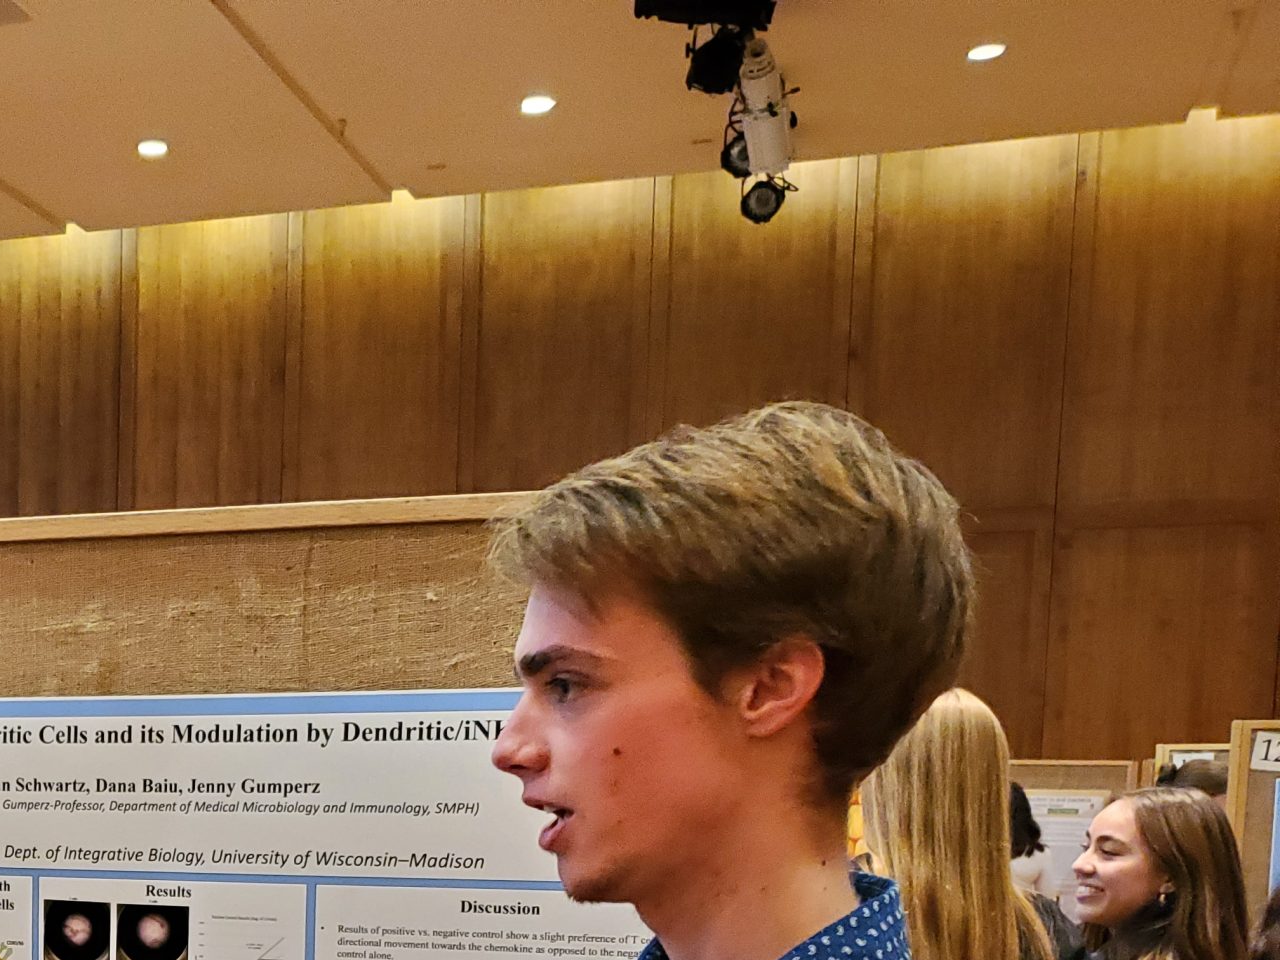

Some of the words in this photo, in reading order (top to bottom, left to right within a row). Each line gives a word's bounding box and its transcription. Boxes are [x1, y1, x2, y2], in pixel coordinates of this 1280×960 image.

[38, 725, 87, 744] Cells
[94, 724, 132, 744] and
[140, 724, 164, 743] its
[171, 723, 297, 743] Modulation
[307, 722, 334, 748] by
[15, 777, 90, 795] Schwartz,
[95, 778, 135, 792] Dana
[142, 778, 182, 796] Baiu,
[187, 778, 235, 797] Jenny
[241, 778, 320, 798] Gumperz
[2, 799, 104, 813] Gumperz-Professor,
[109, 800, 177, 813] Department
[179, 800, 192, 814] of
[193, 801, 239, 812] Medical
[242, 801, 320, 815] Microbiology
[322, 801, 347, 813] and
[349, 802, 430, 816] Immunology,
[434, 802, 479, 816] SMPH)
[4, 844, 40, 861] Dept.
[45, 844, 62, 862] of
[63, 846, 143, 864] Integrative
[148, 847, 205, 866] Biology,
[211, 849, 289, 868] University
[293, 850, 312, 868] of
[315, 851, 484, 869] Wisconsin–Madison
[146, 884, 191, 897] Results
[461, 900, 539, 915] Discussion
[338, 924, 368, 933] Results
[381, 926, 415, 936] positive
[432, 928, 469, 938] negative
[505, 930, 529, 939] show
[539, 932, 564, 943] slight
[567, 933, 616, 943] preference
[336, 950, 366, 958] control
[368, 950, 393, 960] alone.
[337, 936, 381, 947] directional
[383, 941, 429, 949] movement
[431, 941, 466, 950] towards
[468, 942, 482, 951] the
[483, 942, 533, 953] chemokine
[547, 946, 586, 956] opposed
[599, 947, 614, 956] the
